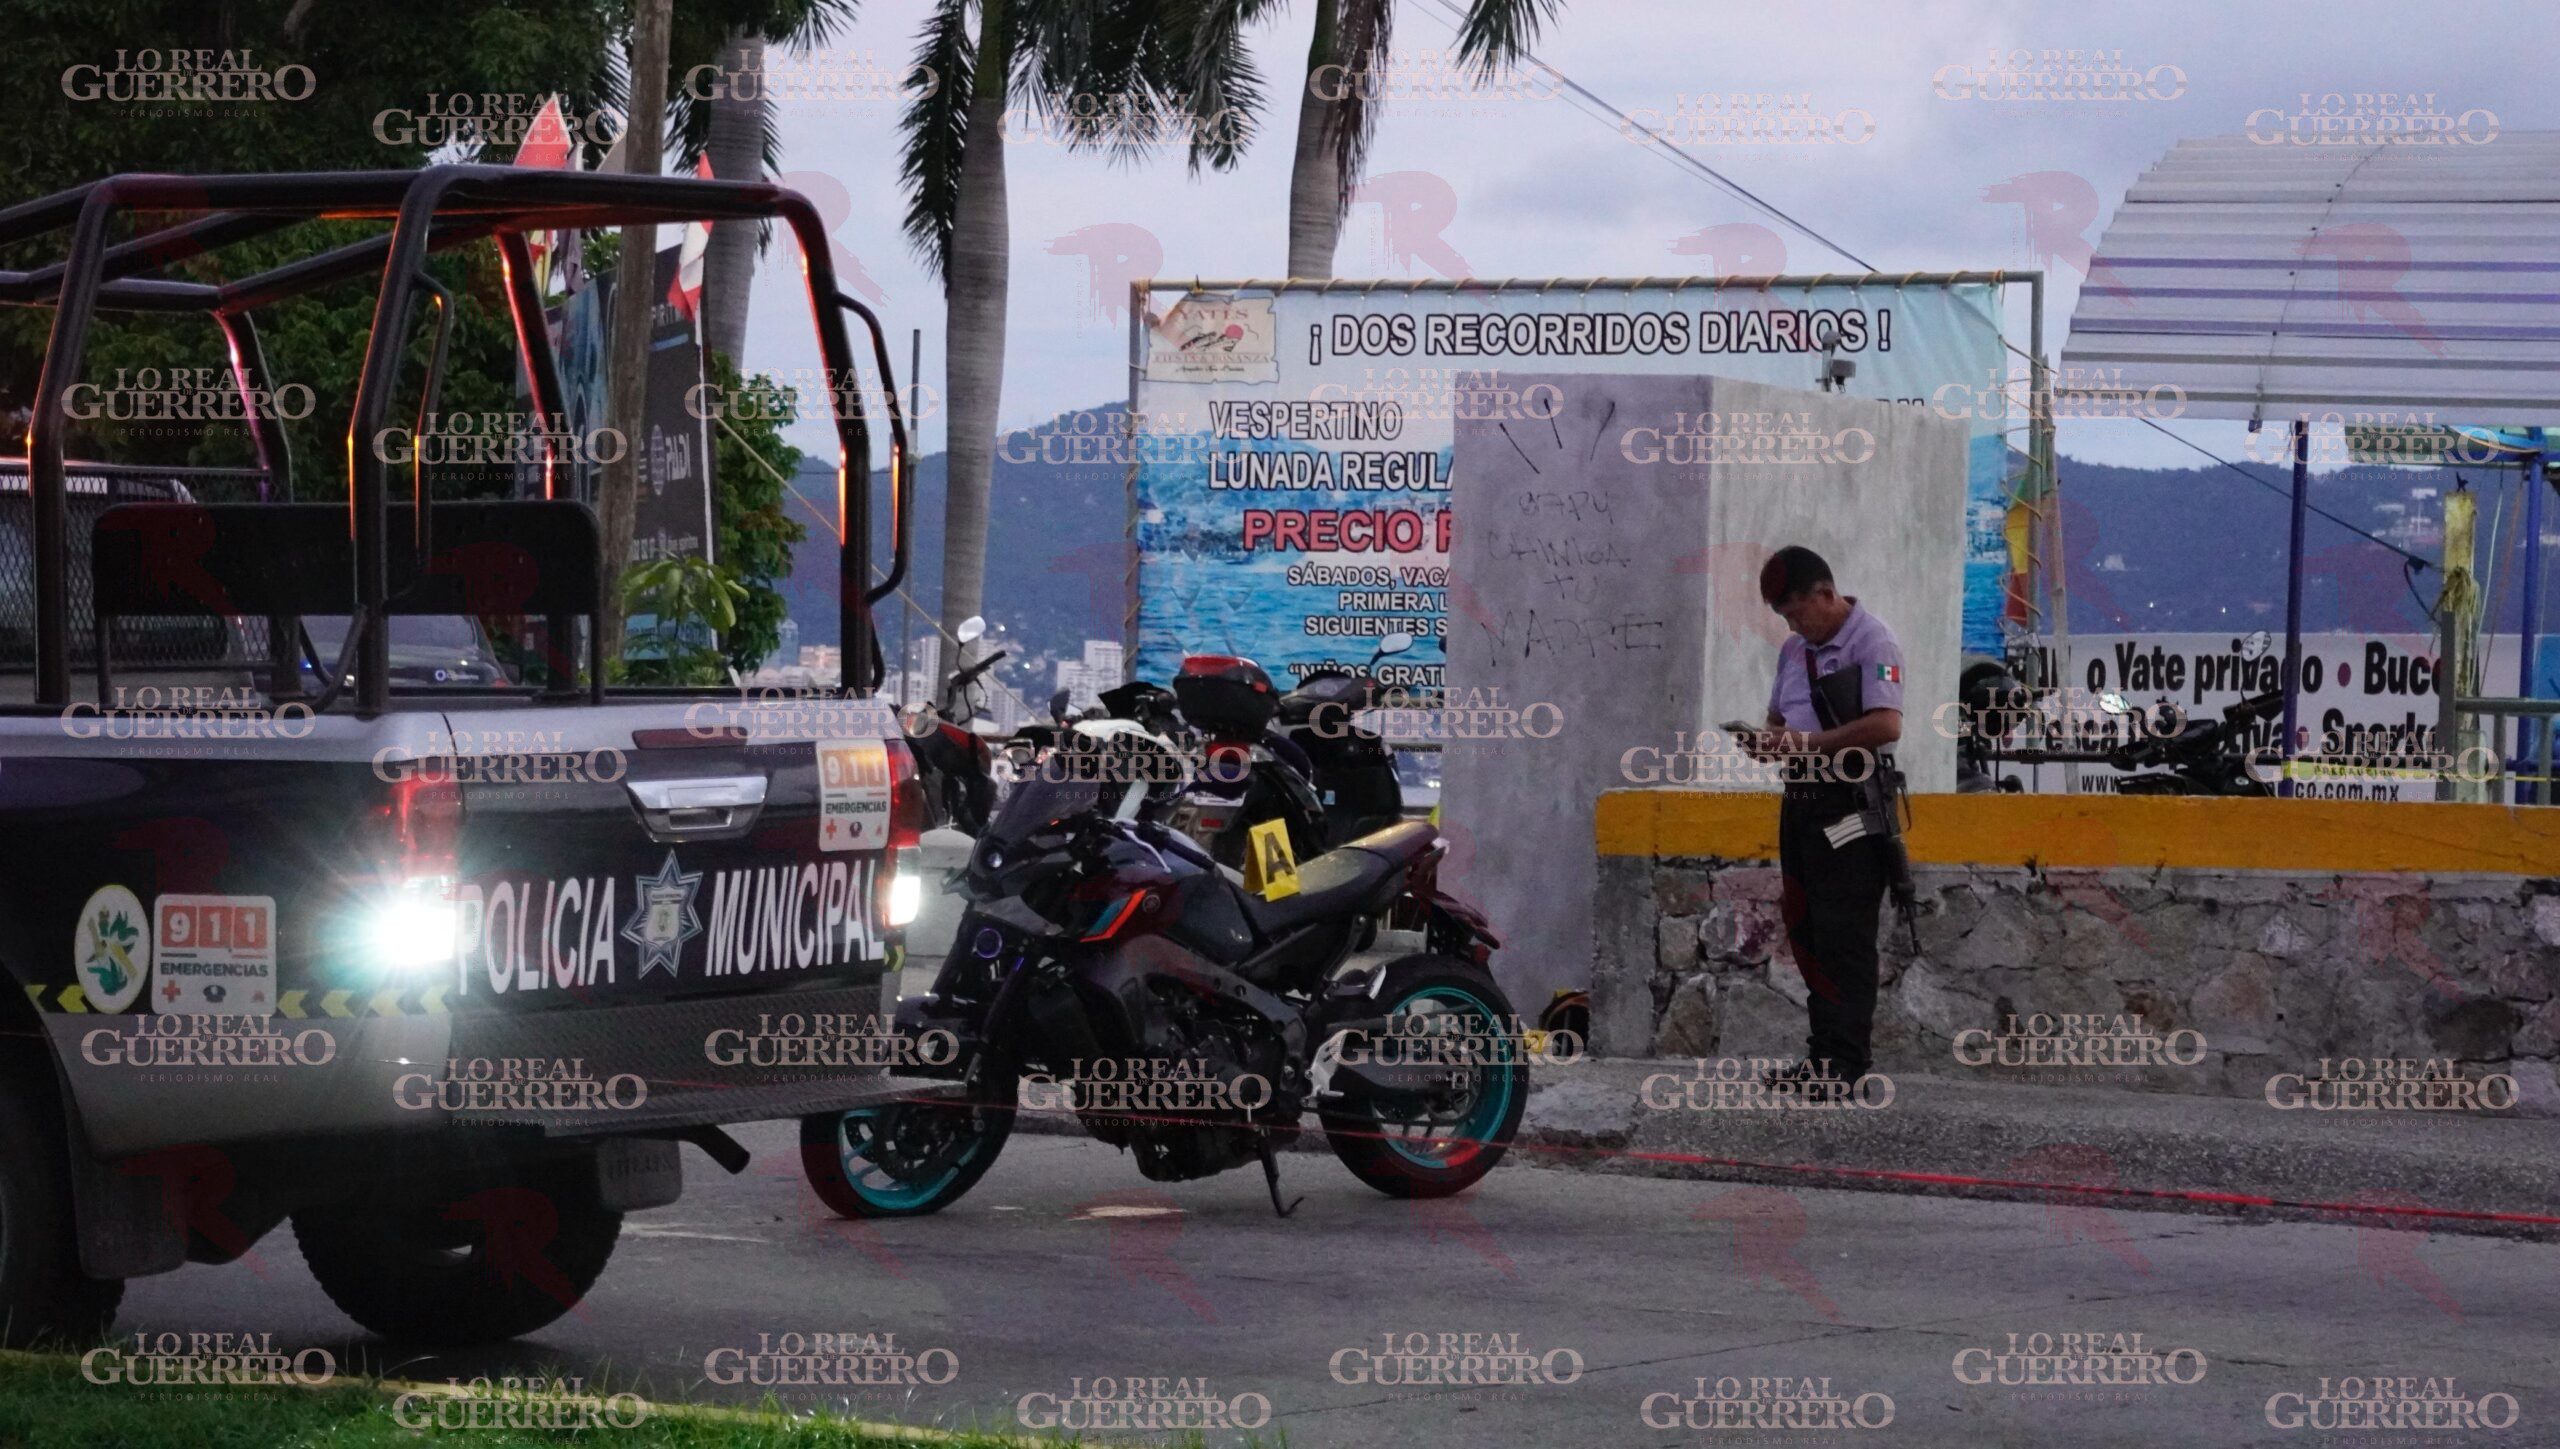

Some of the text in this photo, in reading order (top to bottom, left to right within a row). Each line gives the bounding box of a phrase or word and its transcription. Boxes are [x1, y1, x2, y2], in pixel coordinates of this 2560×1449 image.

[1331, 312, 1417, 356] DOS
[1424, 310, 1691, 356] RECORRIDOS
[1699, 309, 1869, 354] DIARIOS
[1208, 400, 1403, 441] VESPERTINO
[1208, 451, 1335, 491] LUNADA
[1242, 508, 1424, 552] PRECIO
[1287, 561, 1397, 589] SÁBADOS,
[1338, 591, 1434, 612] PRIMERA
[1304, 615, 1430, 636] SIGUIENTES
[2115, 641, 2185, 692] Yate
[2321, 707, 2439, 757] Snork
[827, 754, 880, 785] 911
[825, 801, 887, 815] EMERGENCIAS
[1263, 831, 1296, 885] A
[168, 911, 257, 943] 911
[458, 858, 885, 996] POLICIA MUNICIPAL
[159, 962, 269, 978] EMERGENCIAS
